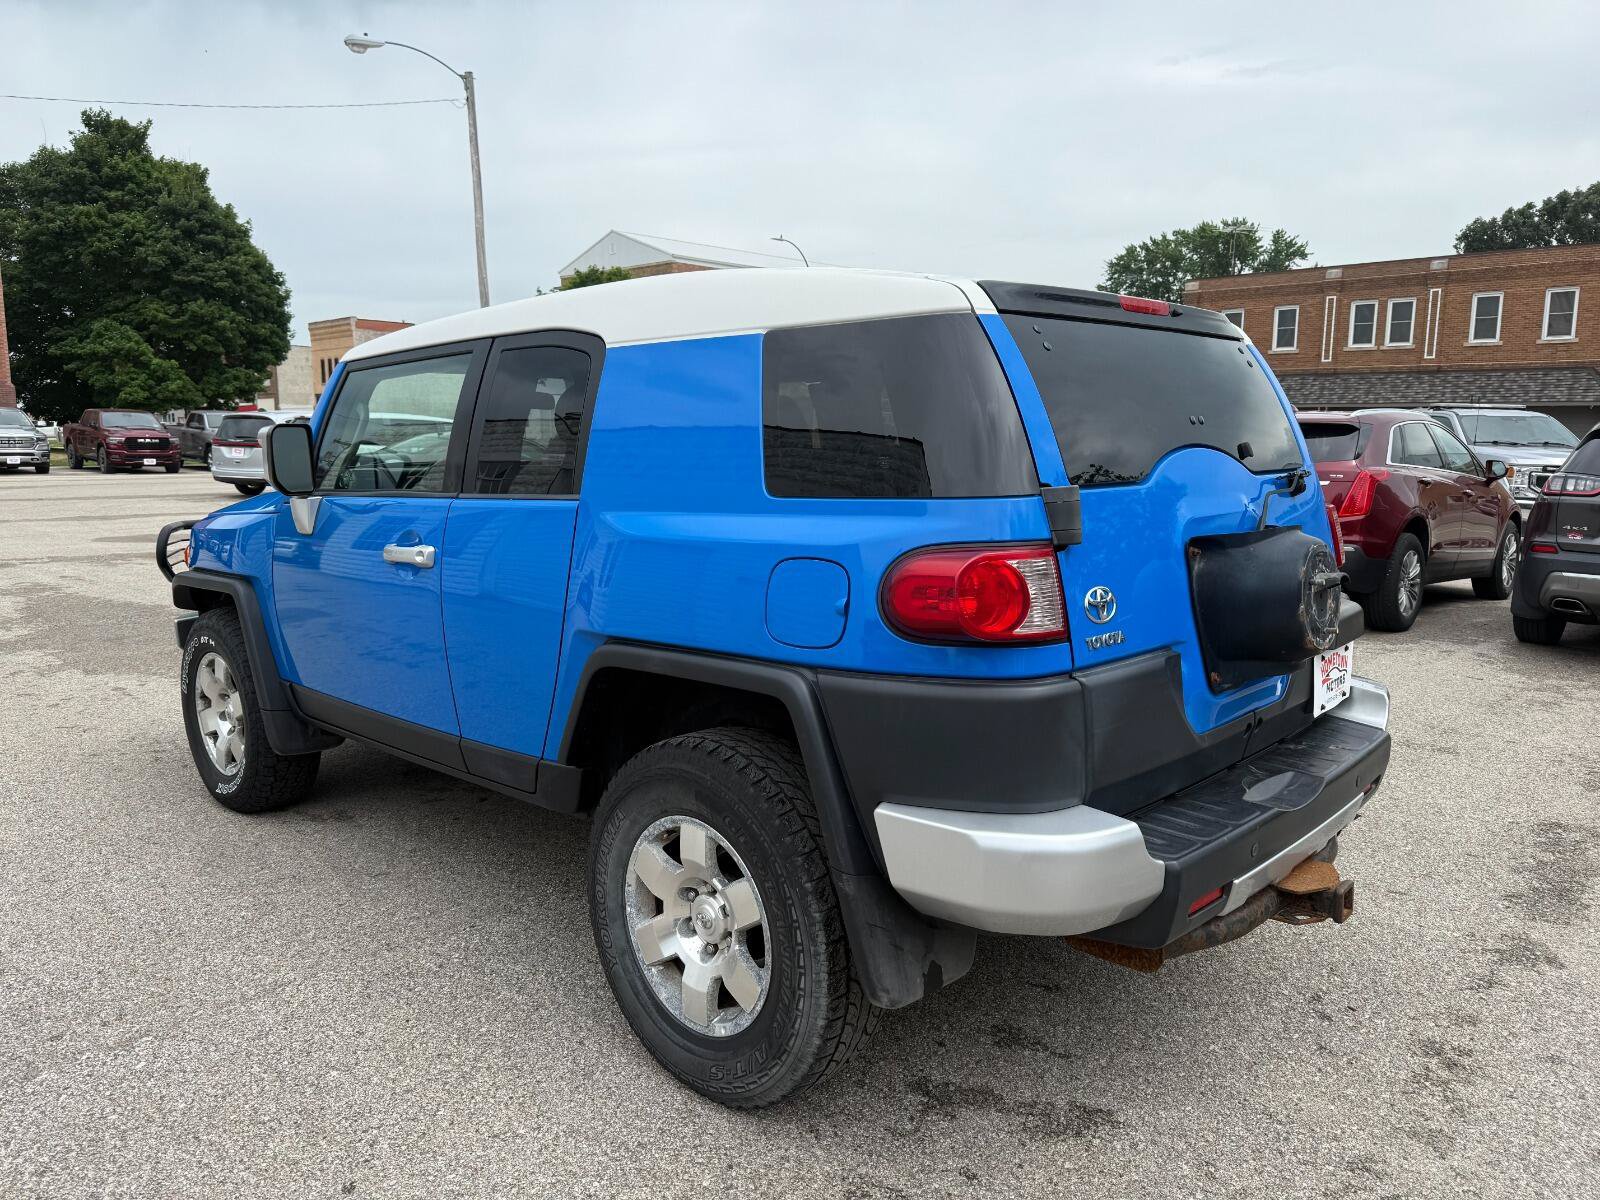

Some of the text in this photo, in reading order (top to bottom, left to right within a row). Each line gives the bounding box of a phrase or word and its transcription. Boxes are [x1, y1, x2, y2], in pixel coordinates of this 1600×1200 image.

[1085, 630, 1126, 650] TOYOTA
[1320, 651, 1349, 678] HOMETOWN
[1326, 673, 1346, 693] MOTORS
[596, 808, 626, 975] YOKOHAMA
